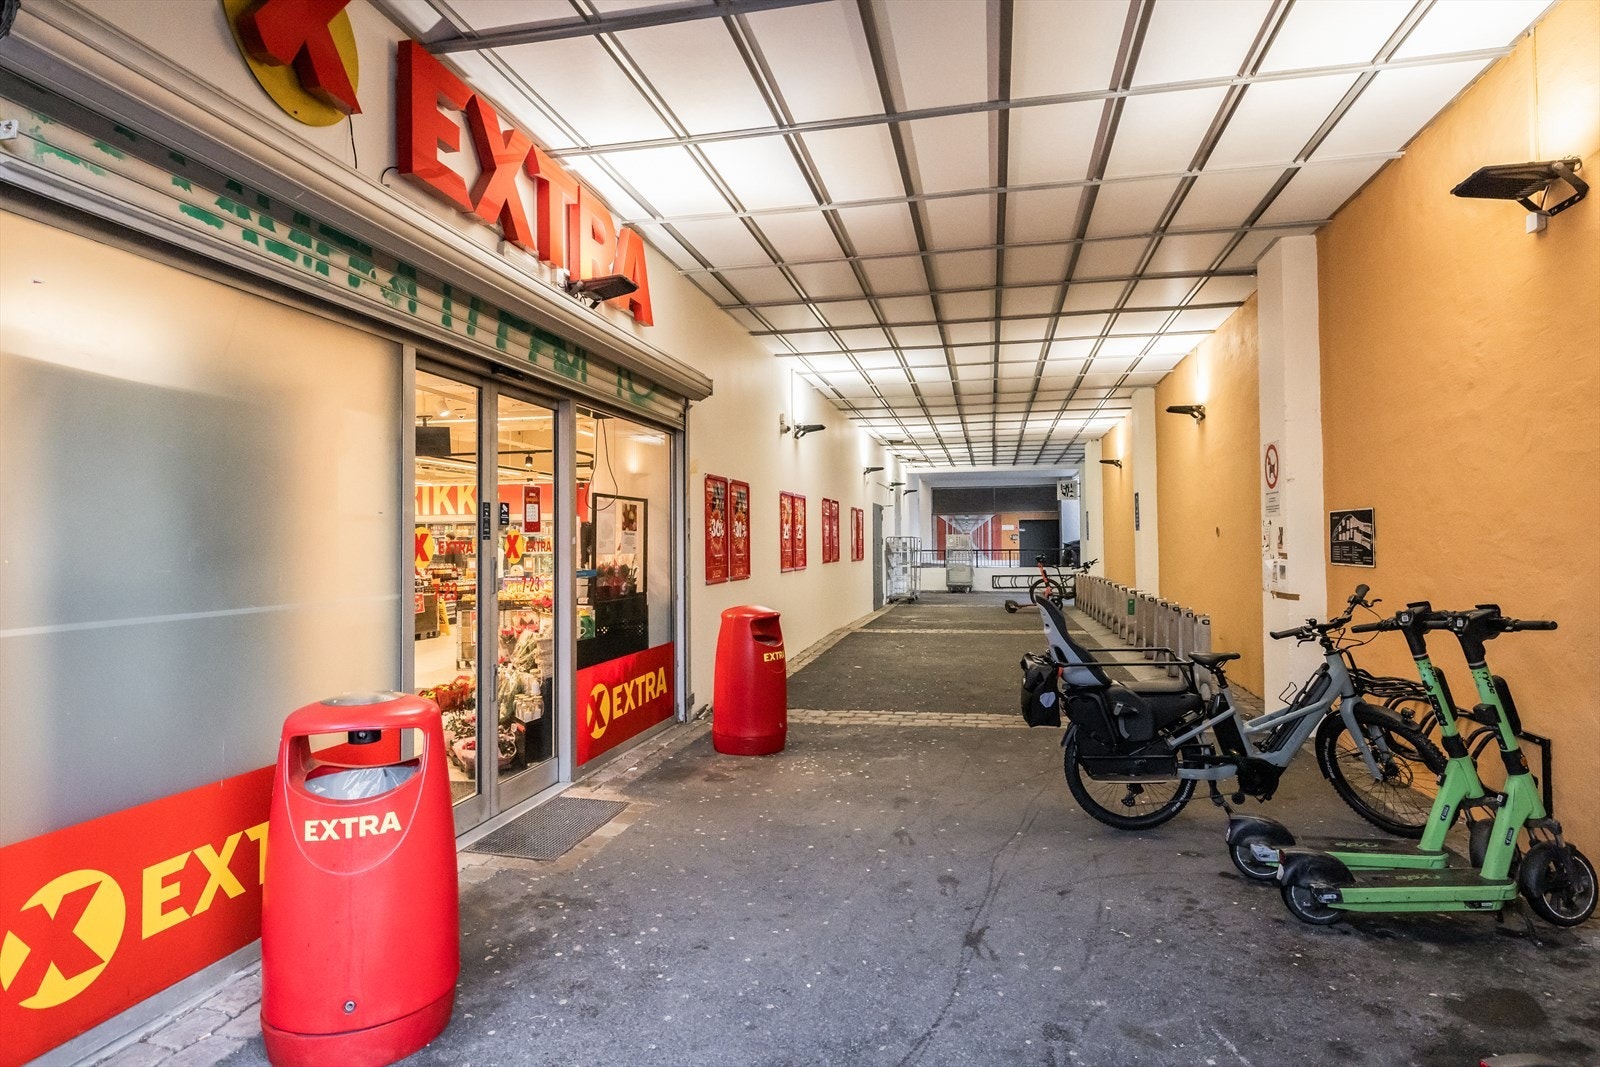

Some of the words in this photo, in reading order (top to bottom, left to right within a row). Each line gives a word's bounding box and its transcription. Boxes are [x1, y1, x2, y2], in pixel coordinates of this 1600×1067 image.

[398, 39, 654, 327] EXTRA
[438, 541, 474, 555] EXTRA
[526, 540, 552, 552] EXTRA
[522, 576, 540, 593] 7-23
[613, 667, 667, 720] EXTRA
[1482, 672, 1495, 694] ryde
[304, 811, 402, 842] EXTRA
[142, 820, 270, 941] EXT
